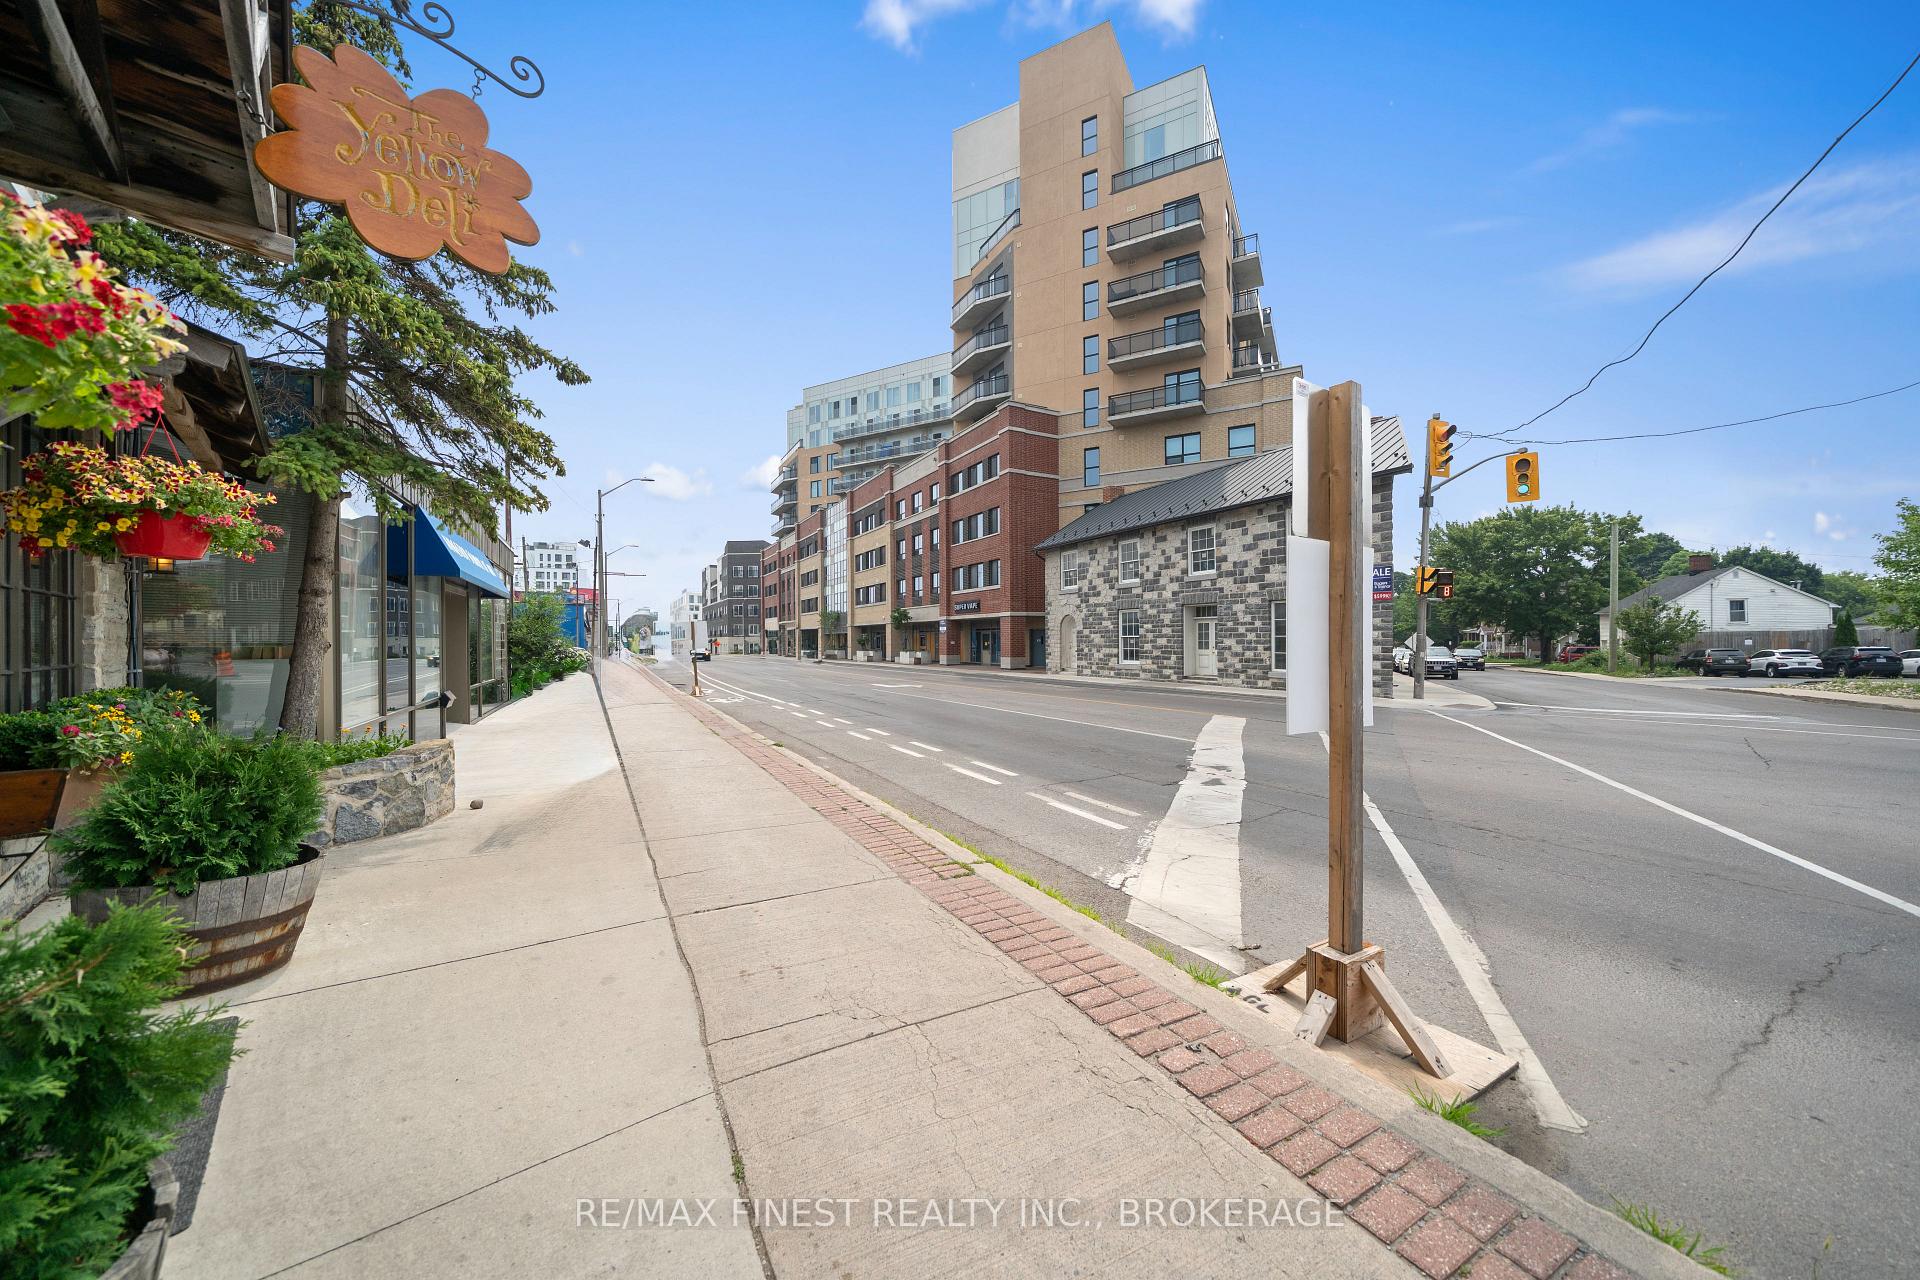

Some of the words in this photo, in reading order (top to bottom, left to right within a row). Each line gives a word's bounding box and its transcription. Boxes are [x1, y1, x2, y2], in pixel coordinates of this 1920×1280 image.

[330, 98, 493, 190] Yellow
[351, 86, 465, 152] The
[359, 168, 482, 247] Deli
[1373, 567, 1391, 576] ALE
